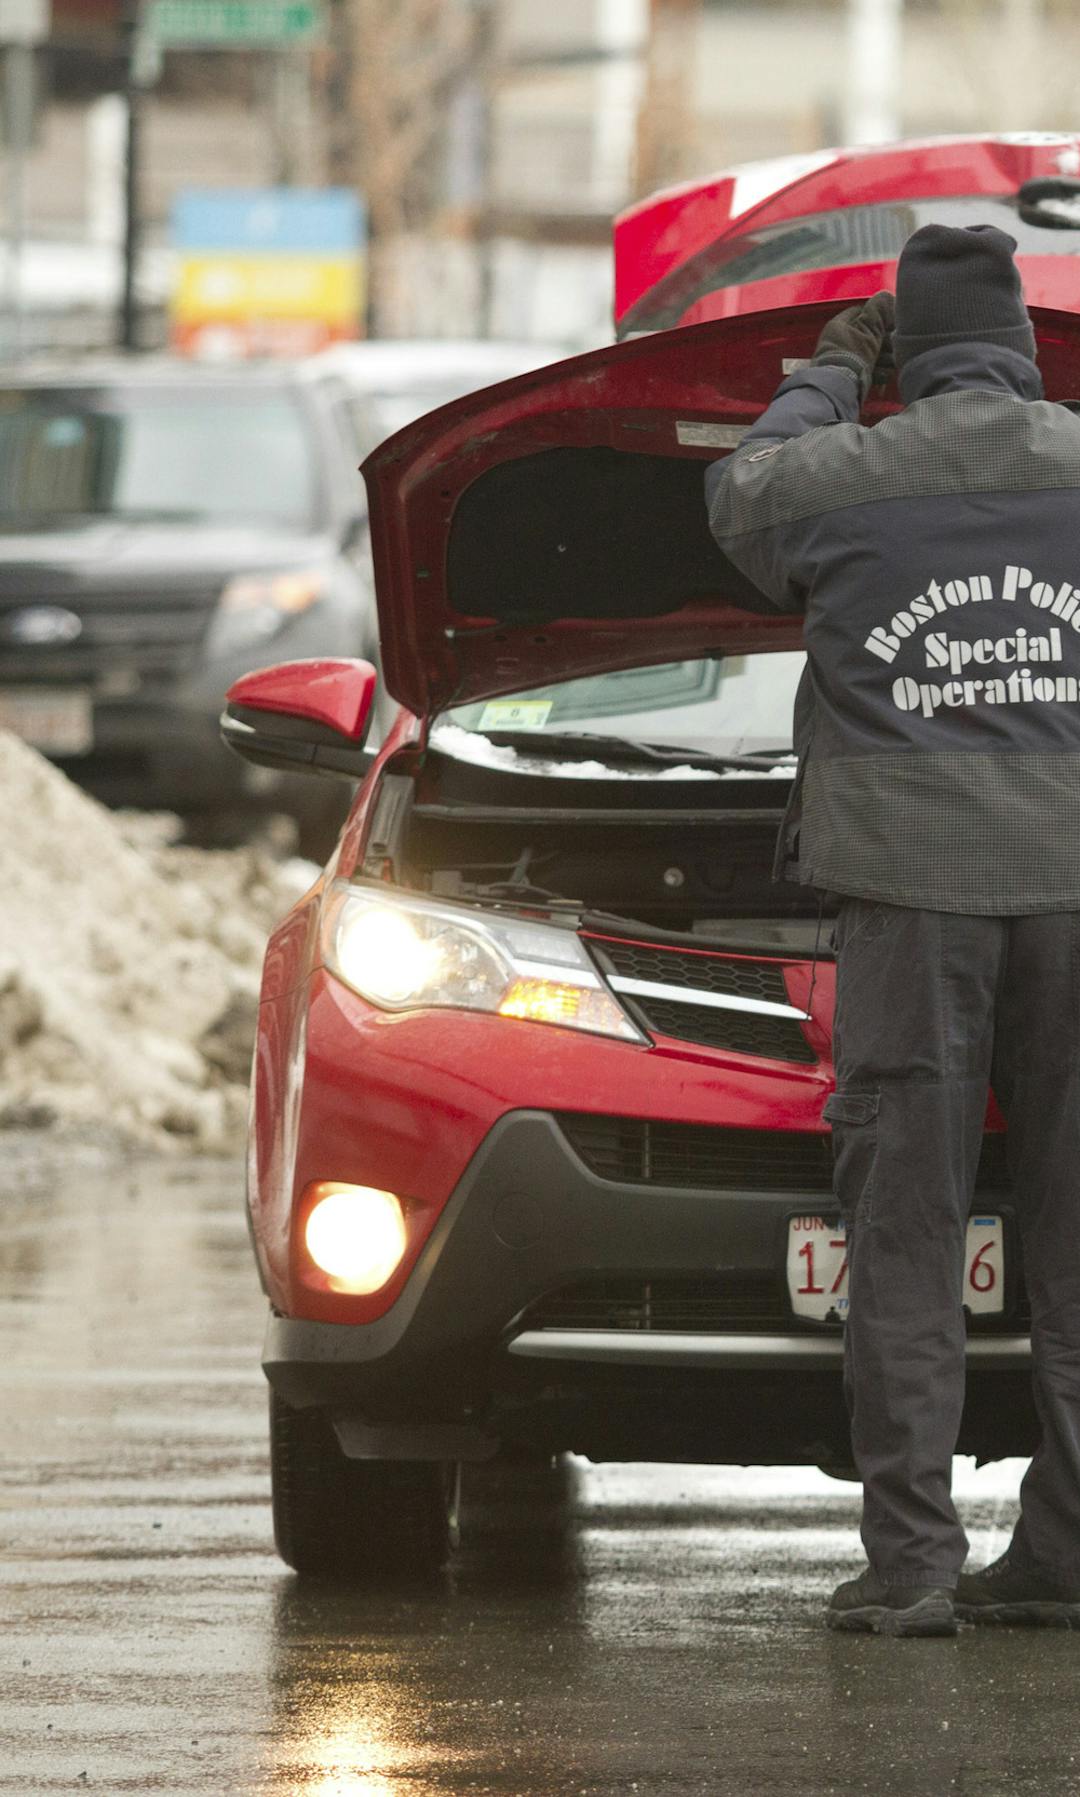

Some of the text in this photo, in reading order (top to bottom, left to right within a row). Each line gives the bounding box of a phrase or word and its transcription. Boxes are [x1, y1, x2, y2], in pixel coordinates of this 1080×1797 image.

[864, 575, 994, 664] Boston
[924, 627, 1063, 675] Special
[793, 1217, 824, 1231] JUN
[797, 1241, 848, 1294] 17
